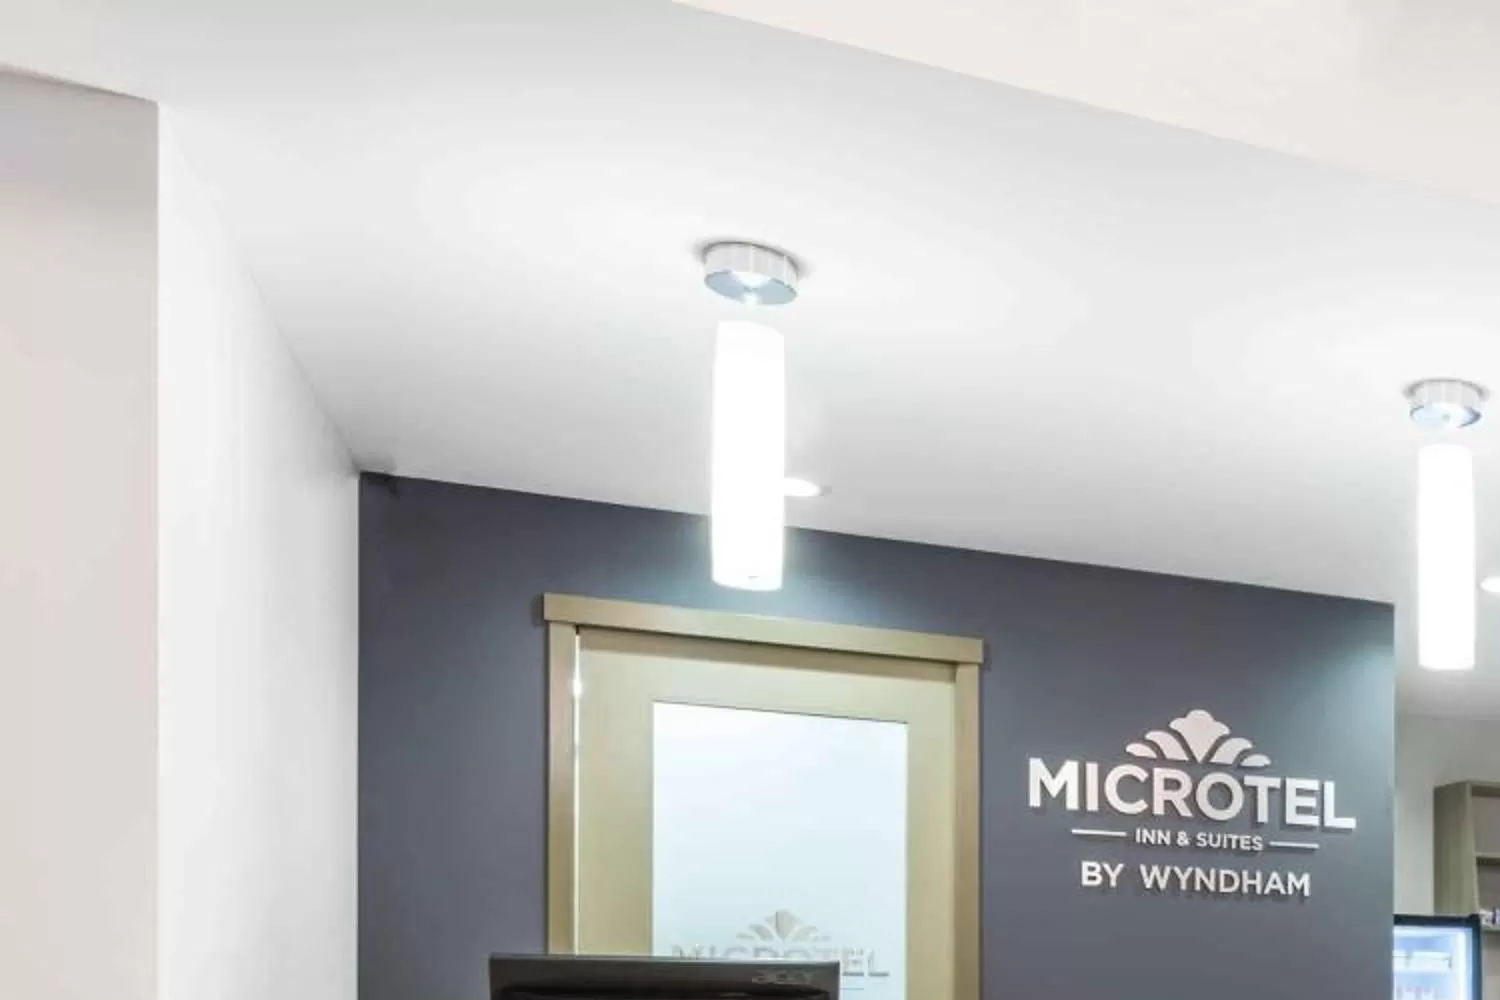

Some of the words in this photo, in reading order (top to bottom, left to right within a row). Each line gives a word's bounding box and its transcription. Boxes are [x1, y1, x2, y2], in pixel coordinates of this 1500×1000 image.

[1028, 757, 1357, 829] MICROTEL
[1135, 827, 1171, 847] INN
[1177, 829, 1190, 847] &
[1196, 831, 1263, 851] SUITES
[1080, 860, 1125, 888] BY
[1139, 864, 1311, 897] WYNDHAM
